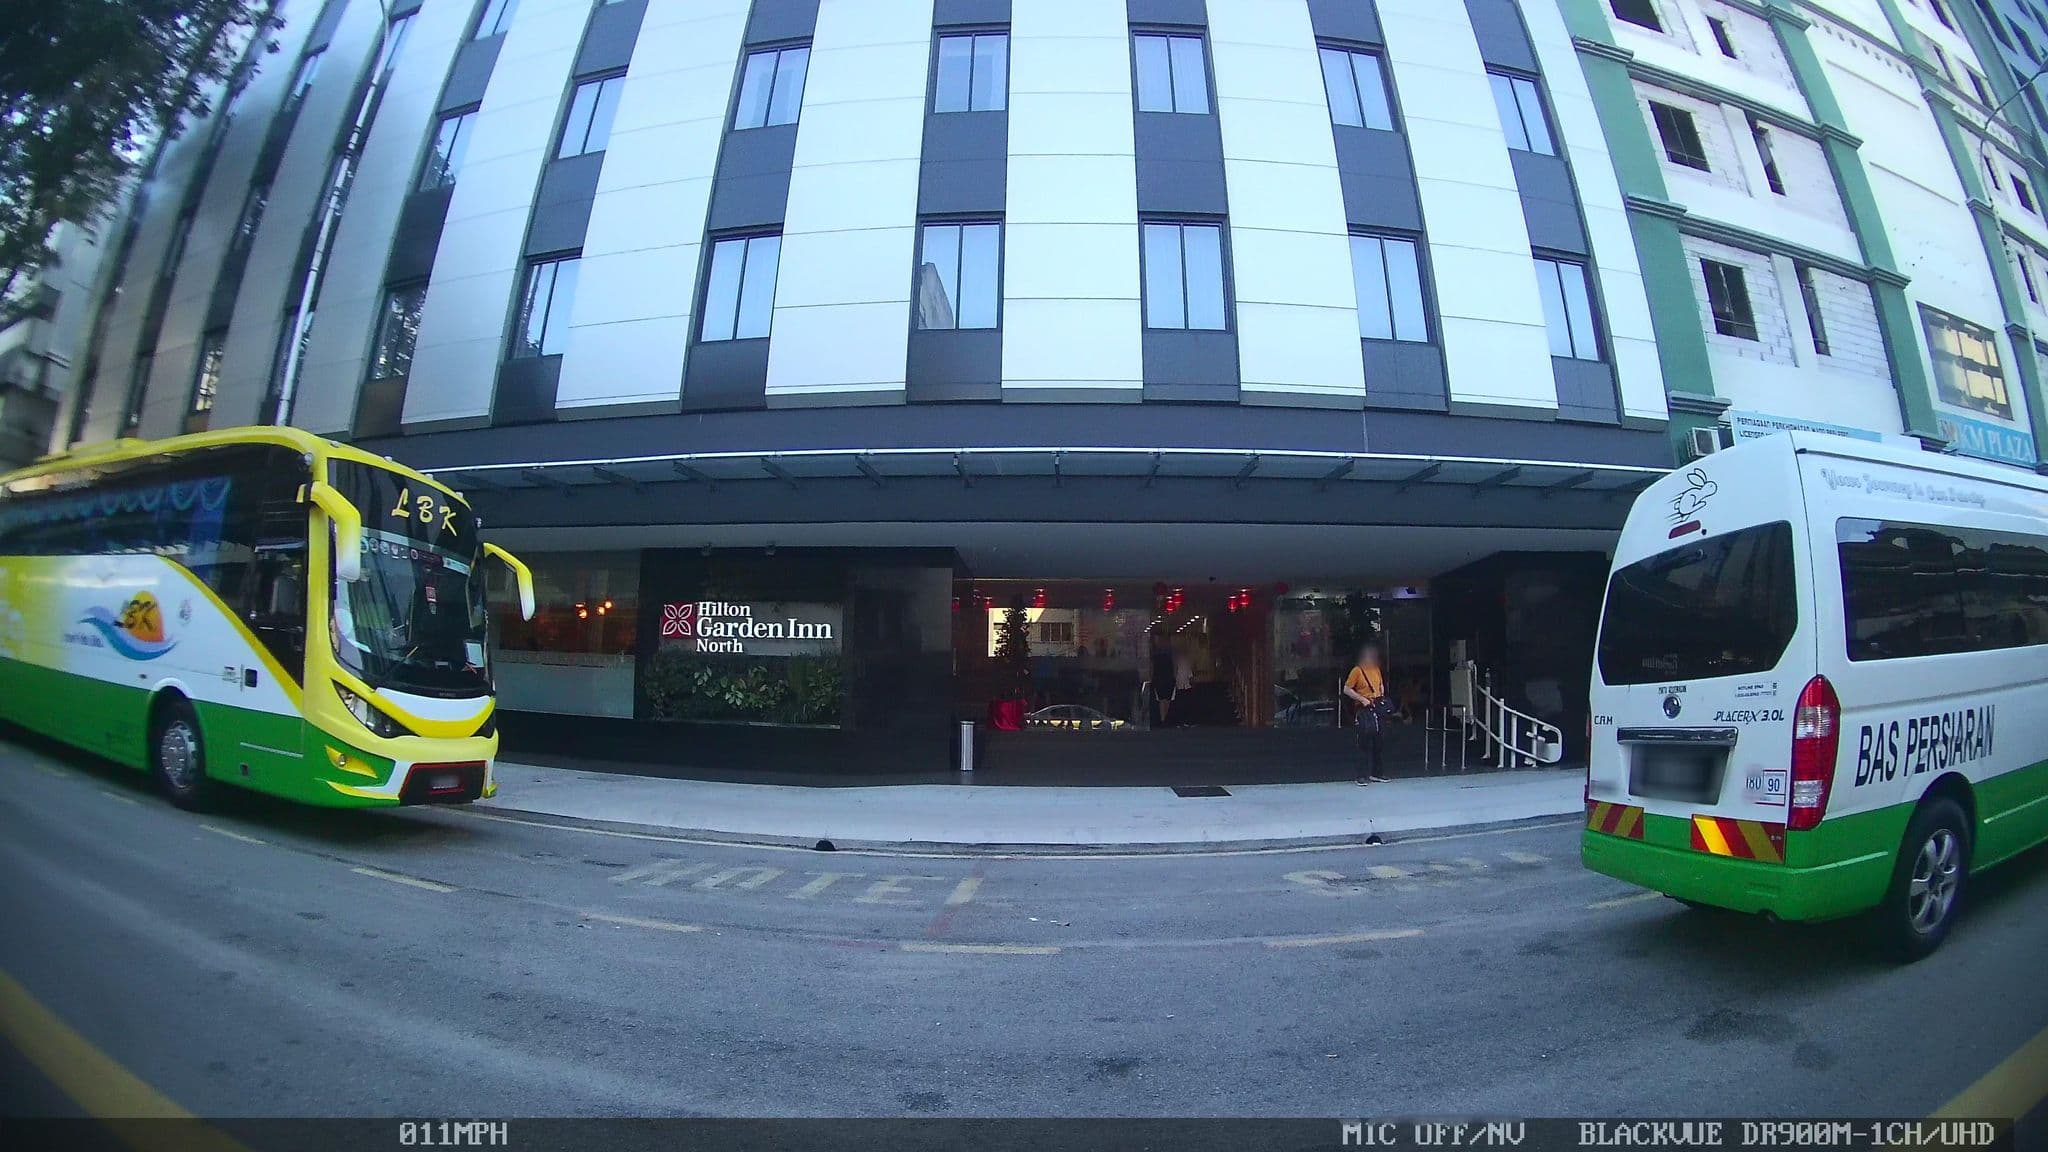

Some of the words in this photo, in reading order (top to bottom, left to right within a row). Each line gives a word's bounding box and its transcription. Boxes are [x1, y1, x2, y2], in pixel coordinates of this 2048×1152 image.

[1987, 430, 2036, 463] PLAZA
[391, 487, 457, 537] LBK
[699, 601, 751, 616] Hilton
[696, 617, 784, 638] Garden
[787, 618, 833, 638] Inn
[696, 639, 744, 653] North
[1763, 709, 1785, 722] 3.0L
[1855, 720, 1899, 787] BAS
[1904, 704, 1996, 777] PERSIARAN
[1767, 778, 1780, 792] 90
